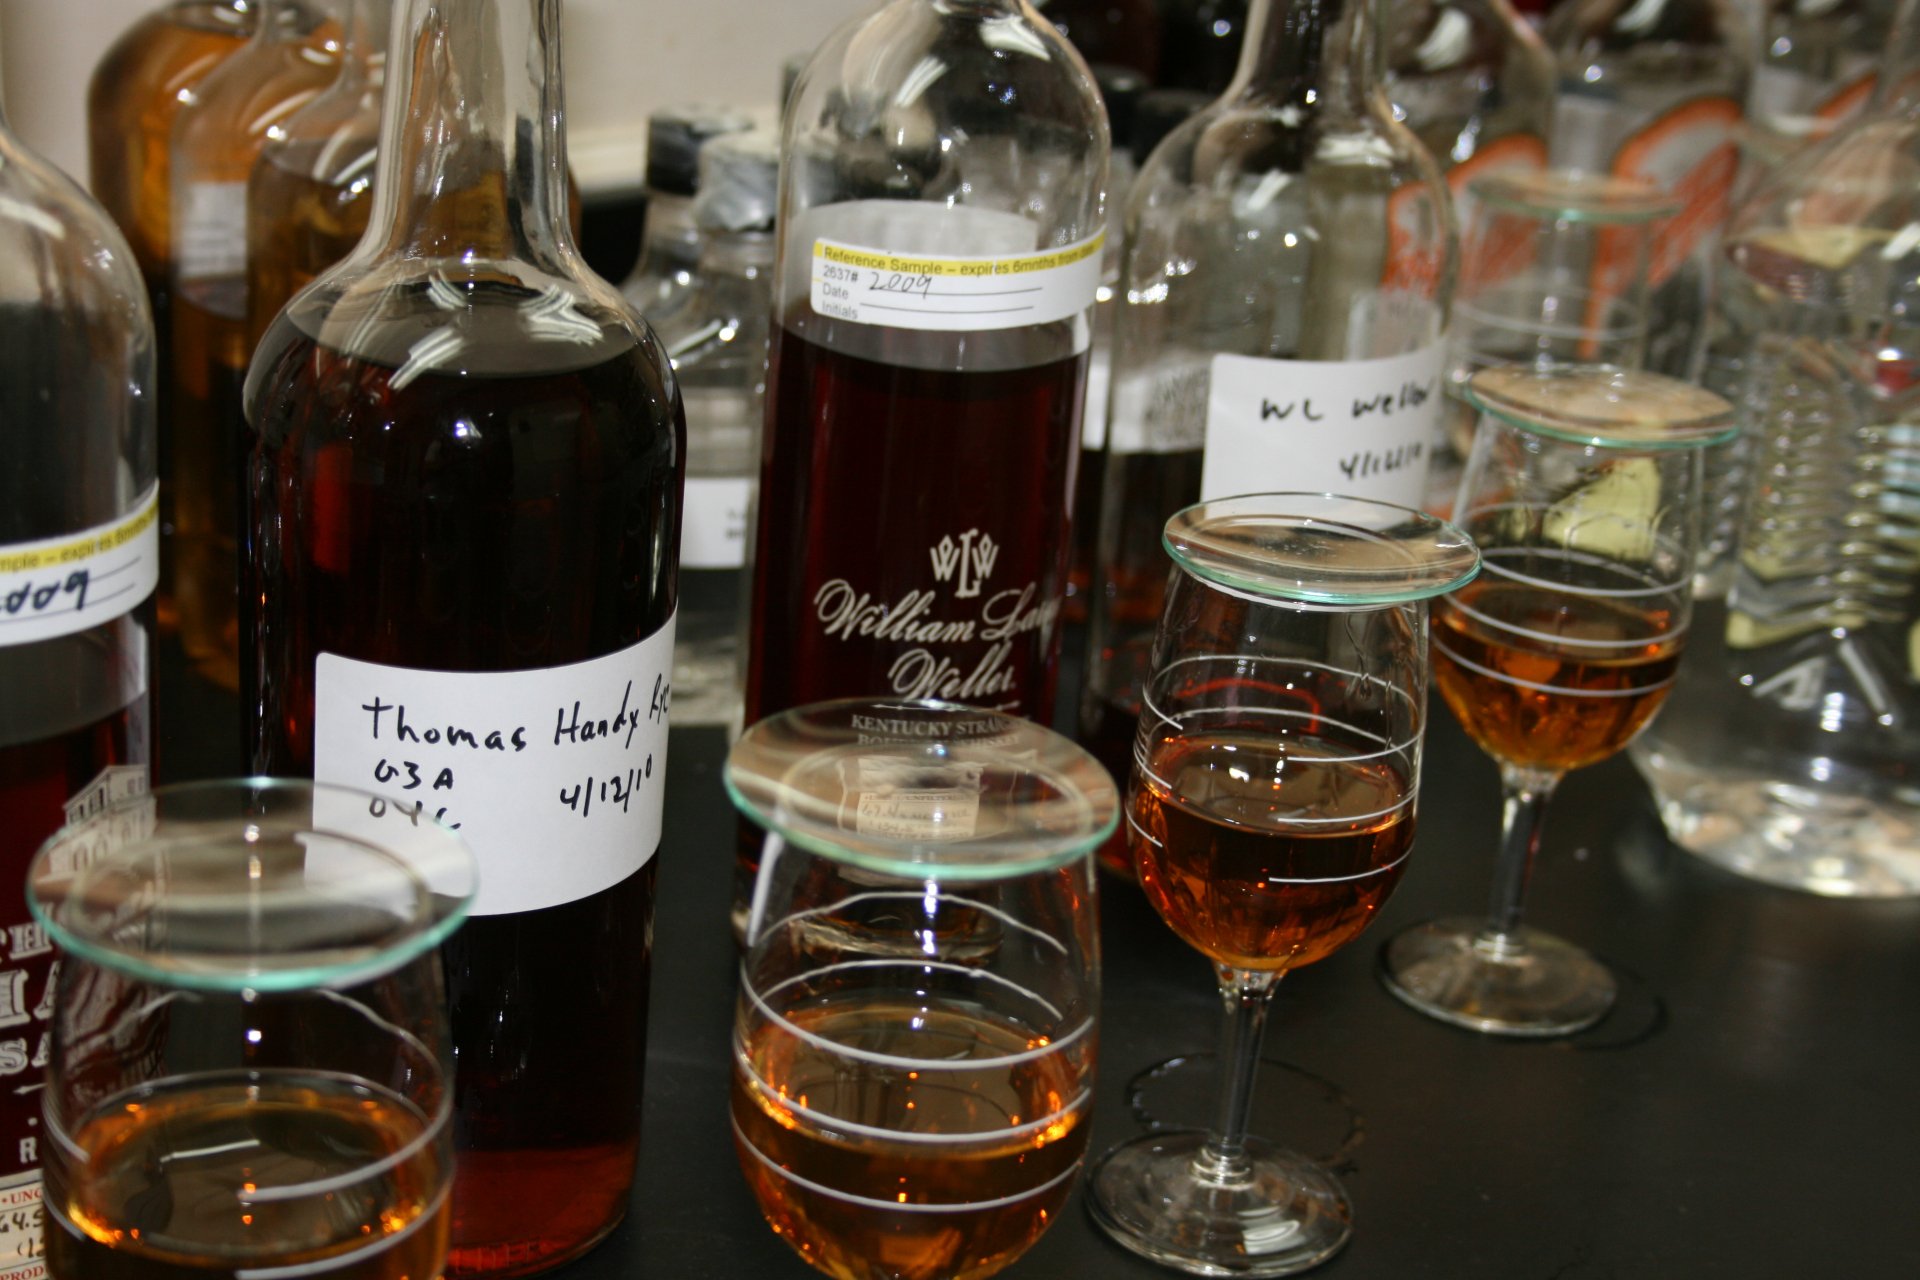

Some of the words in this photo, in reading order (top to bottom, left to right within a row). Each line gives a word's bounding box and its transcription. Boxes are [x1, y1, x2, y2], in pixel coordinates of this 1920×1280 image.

[823, 246, 886, 271] Reference
[889, 259, 943, 277] Sample
[959, 262, 1010, 278] expires
[822, 282, 849, 300] Date
[869, 271, 933, 300] 2009
[822, 301, 859, 320] Initials
[813, 578, 976, 642] William
[361, 696, 527, 751] Thomas
[554, 680, 640, 750] Handy
[850, 713, 953, 737] KENTUCKY
